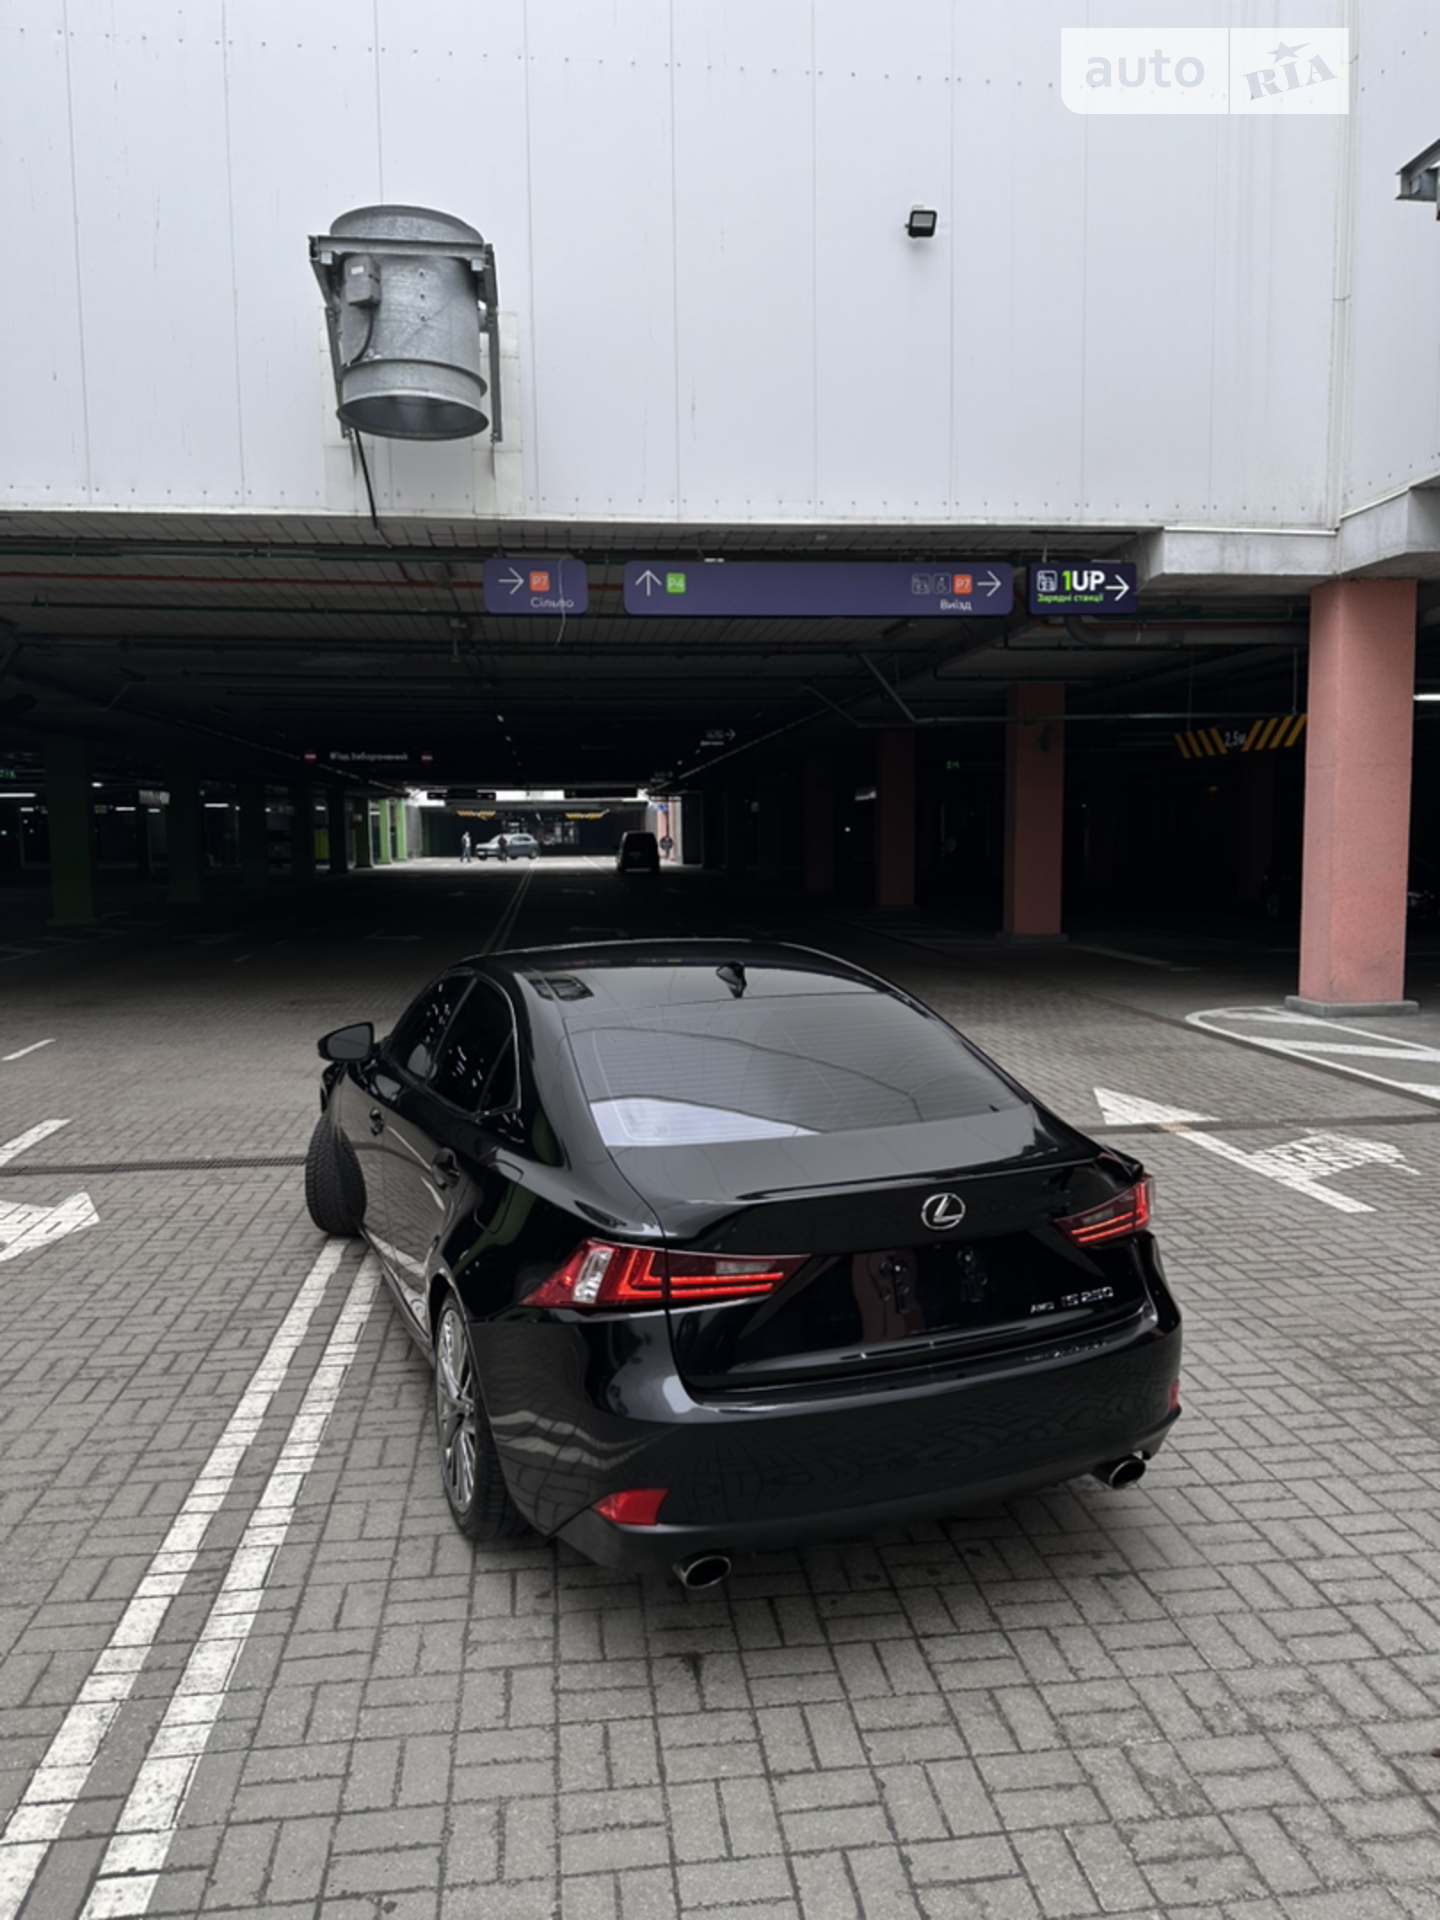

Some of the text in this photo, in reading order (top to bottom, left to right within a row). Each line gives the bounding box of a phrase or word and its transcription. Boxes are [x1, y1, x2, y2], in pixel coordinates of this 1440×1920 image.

[531, 574, 549, 588] P7
[667, 576, 685, 589] P4
[955, 578, 971, 590] P7
[1062, 570, 1105, 591] 1UP
[1037, 592, 1104, 603] Зарядні станції
[940, 599, 973, 611] Виїзд
